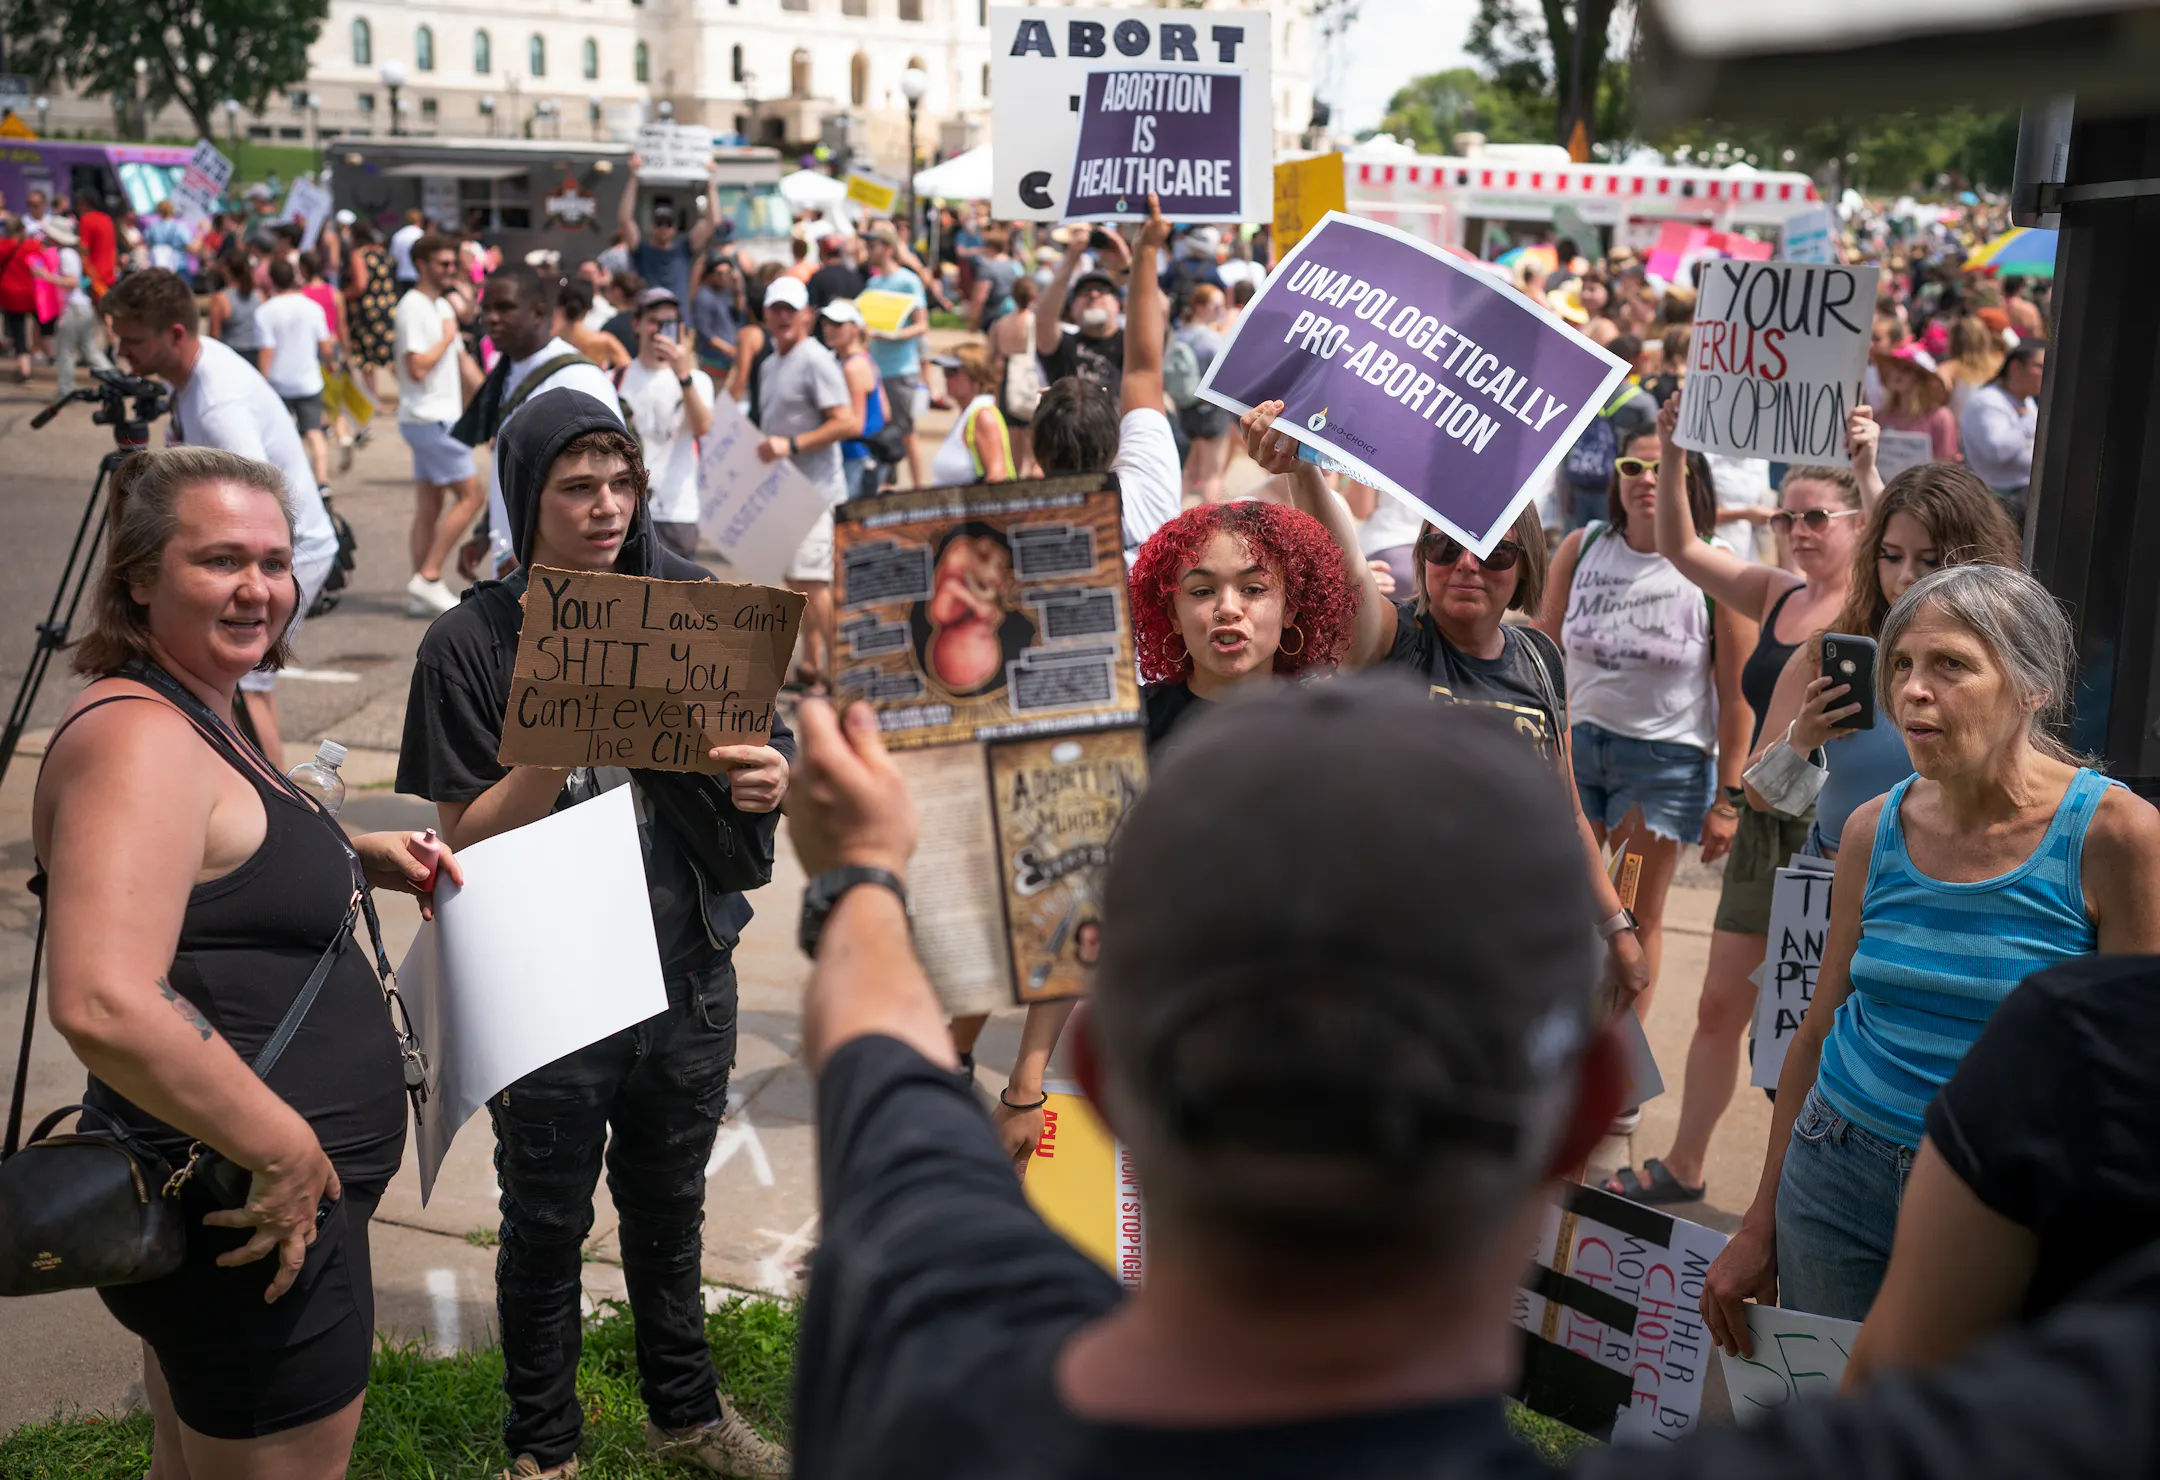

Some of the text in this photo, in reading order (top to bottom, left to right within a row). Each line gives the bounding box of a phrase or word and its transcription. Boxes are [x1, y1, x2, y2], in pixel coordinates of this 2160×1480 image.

[1008, 18, 1245, 64] ABORT
[1100, 72, 1213, 114] ABORTION
[1131, 114, 1158, 154] IS
[1076, 156, 1233, 198] HEALTHCARE
[1722, 262, 1863, 338] YOUR
[1285, 259, 1570, 434] UNAPOLOGETICALLY
[1283, 309, 1502, 456] PRO-ABORTION
[1326, 421, 1378, 456] PRO-CHOICE
[1729, 375, 1863, 462] OPINION
[541, 576, 789, 633] Your Laws ain't
[532, 635, 650, 690] SHIT
[517, 685, 772, 734] Can't even find
[573, 727, 708, 766] The Clit
[1780, 925, 1830, 962] AN
[1121, 1202, 1142, 1244] STOP
[1663, 1248, 1711, 1384] MOTHER
